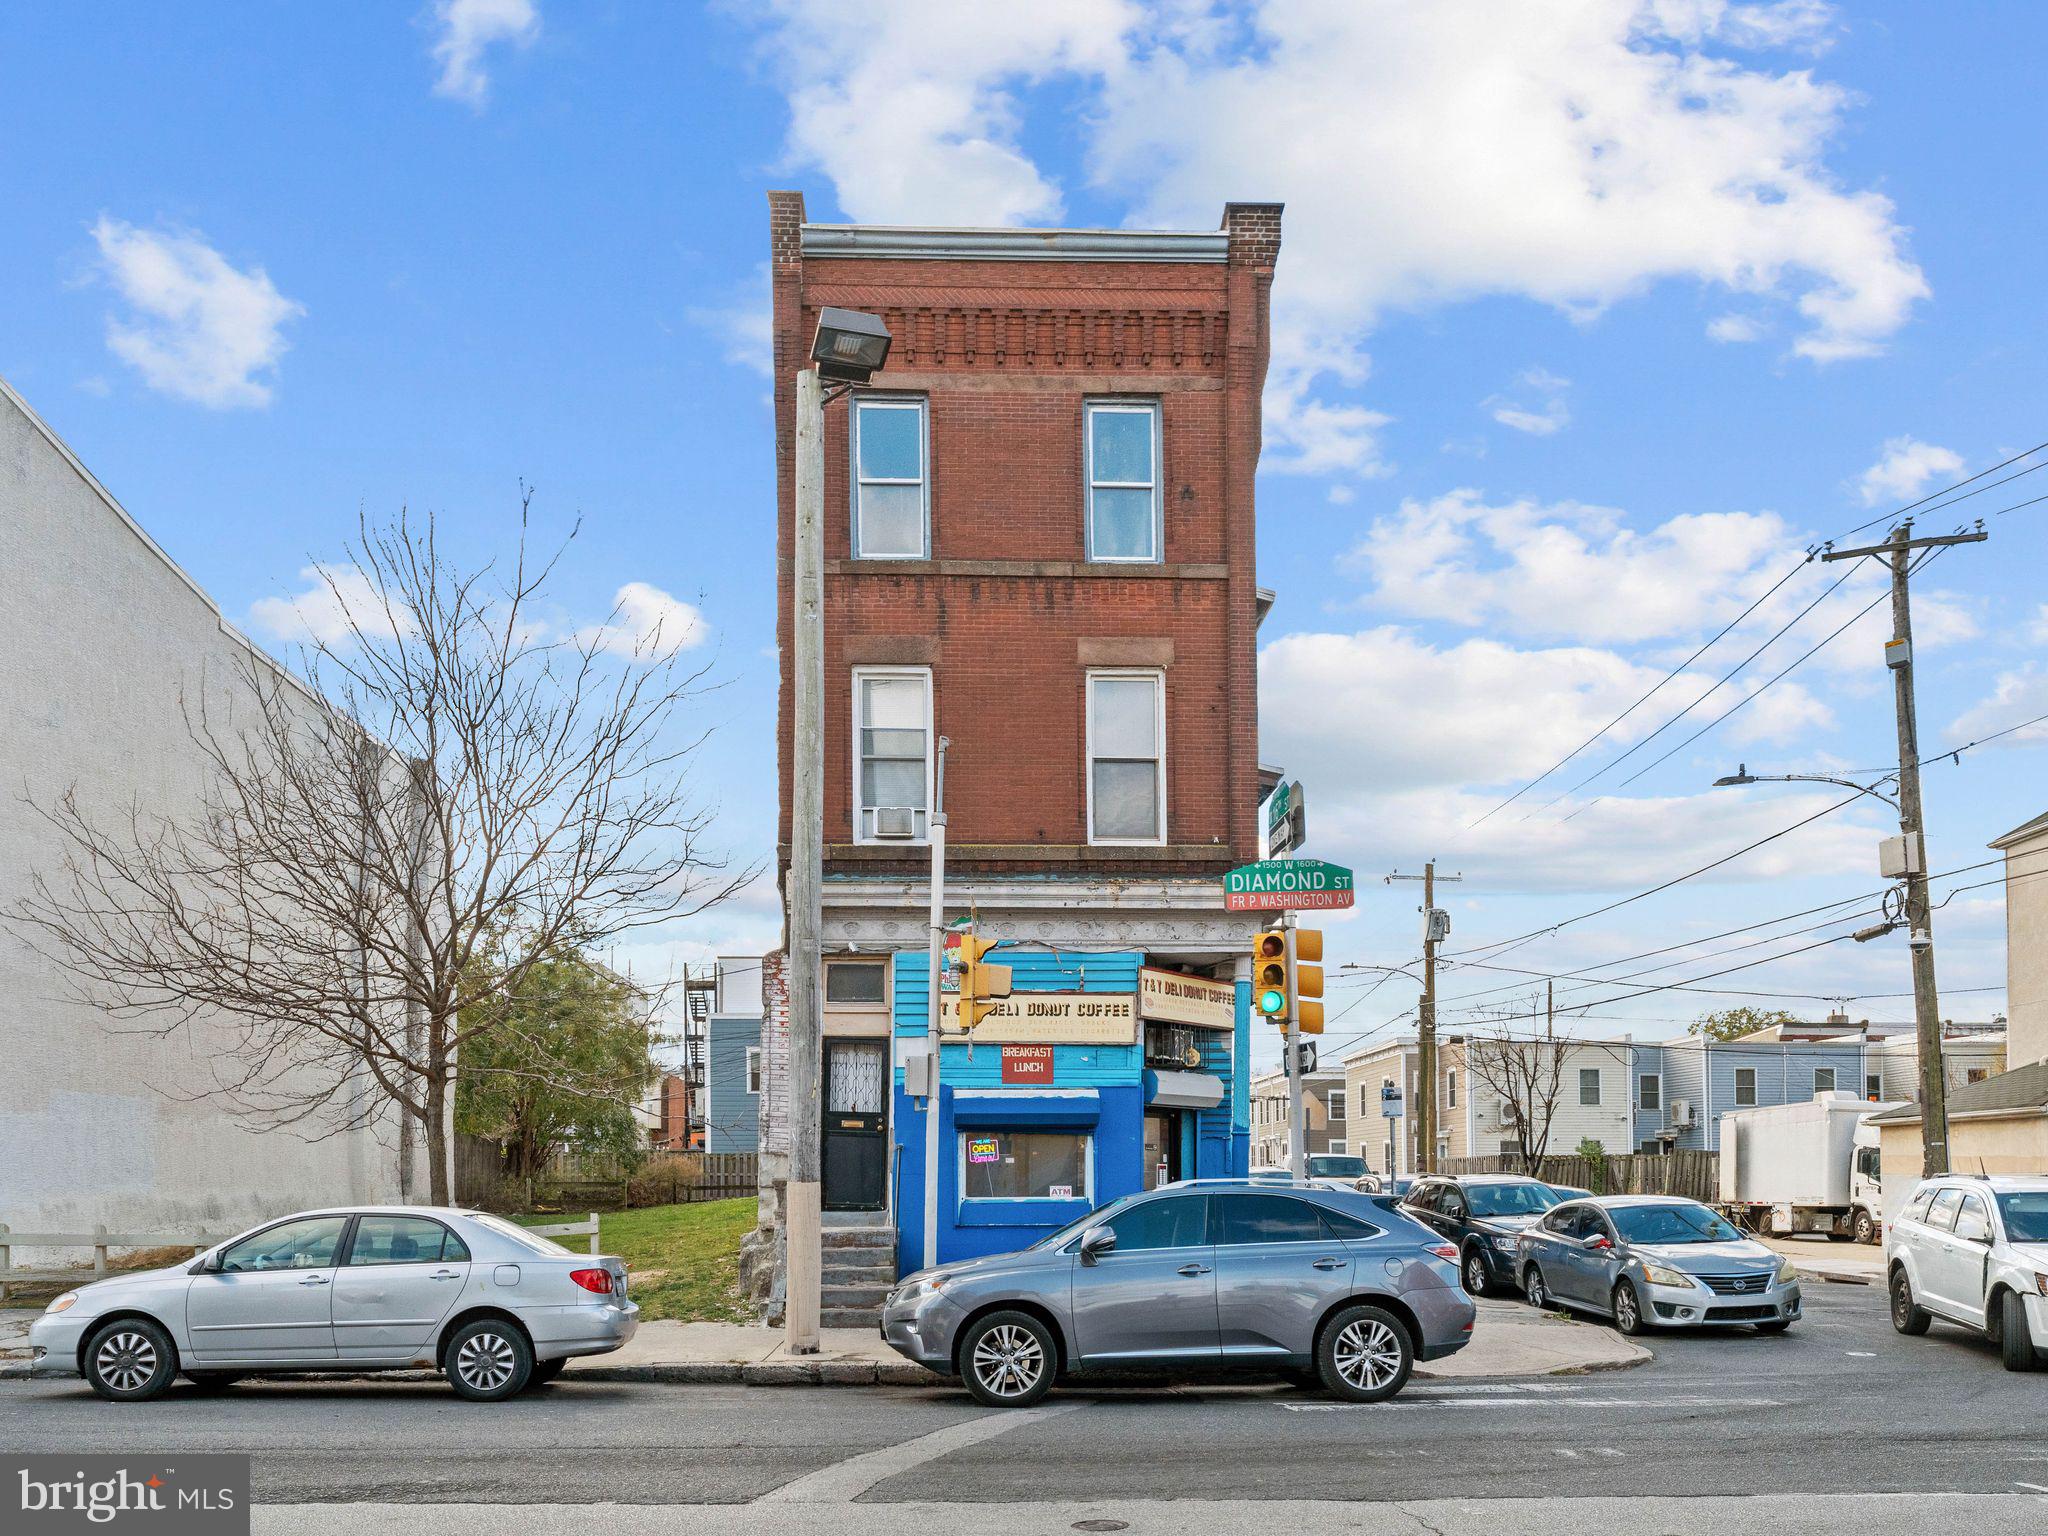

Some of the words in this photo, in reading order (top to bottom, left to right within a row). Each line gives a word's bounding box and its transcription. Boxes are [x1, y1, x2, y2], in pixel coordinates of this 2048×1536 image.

[1262, 861, 1281, 869] 1500
[1284, 860, 1294, 870] W
[1296, 860, 1316, 868] 1600
[1231, 871, 1326, 892] DIAMOND
[1334, 876, 1350, 889] ST
[1232, 895, 1245, 908] FR
[1260, 893, 1333, 907] WASHINGTON
[1336, 893, 1351, 905] AV
[1164, 980, 1182, 997] DELI
[1183, 983, 1207, 1001] DONUT
[1208, 988, 1235, 1006] COFFEE
[1027, 1002, 1070, 1017] DONUT
[1077, 1002, 1130, 1017] COFFEE
[1002, 1047, 1052, 1057] BREAKFAST
[1014, 1062, 1044, 1072] LUNCH
[972, 1144, 995, 1153] OPEN
[1051, 1188, 1071, 1196] ATM
